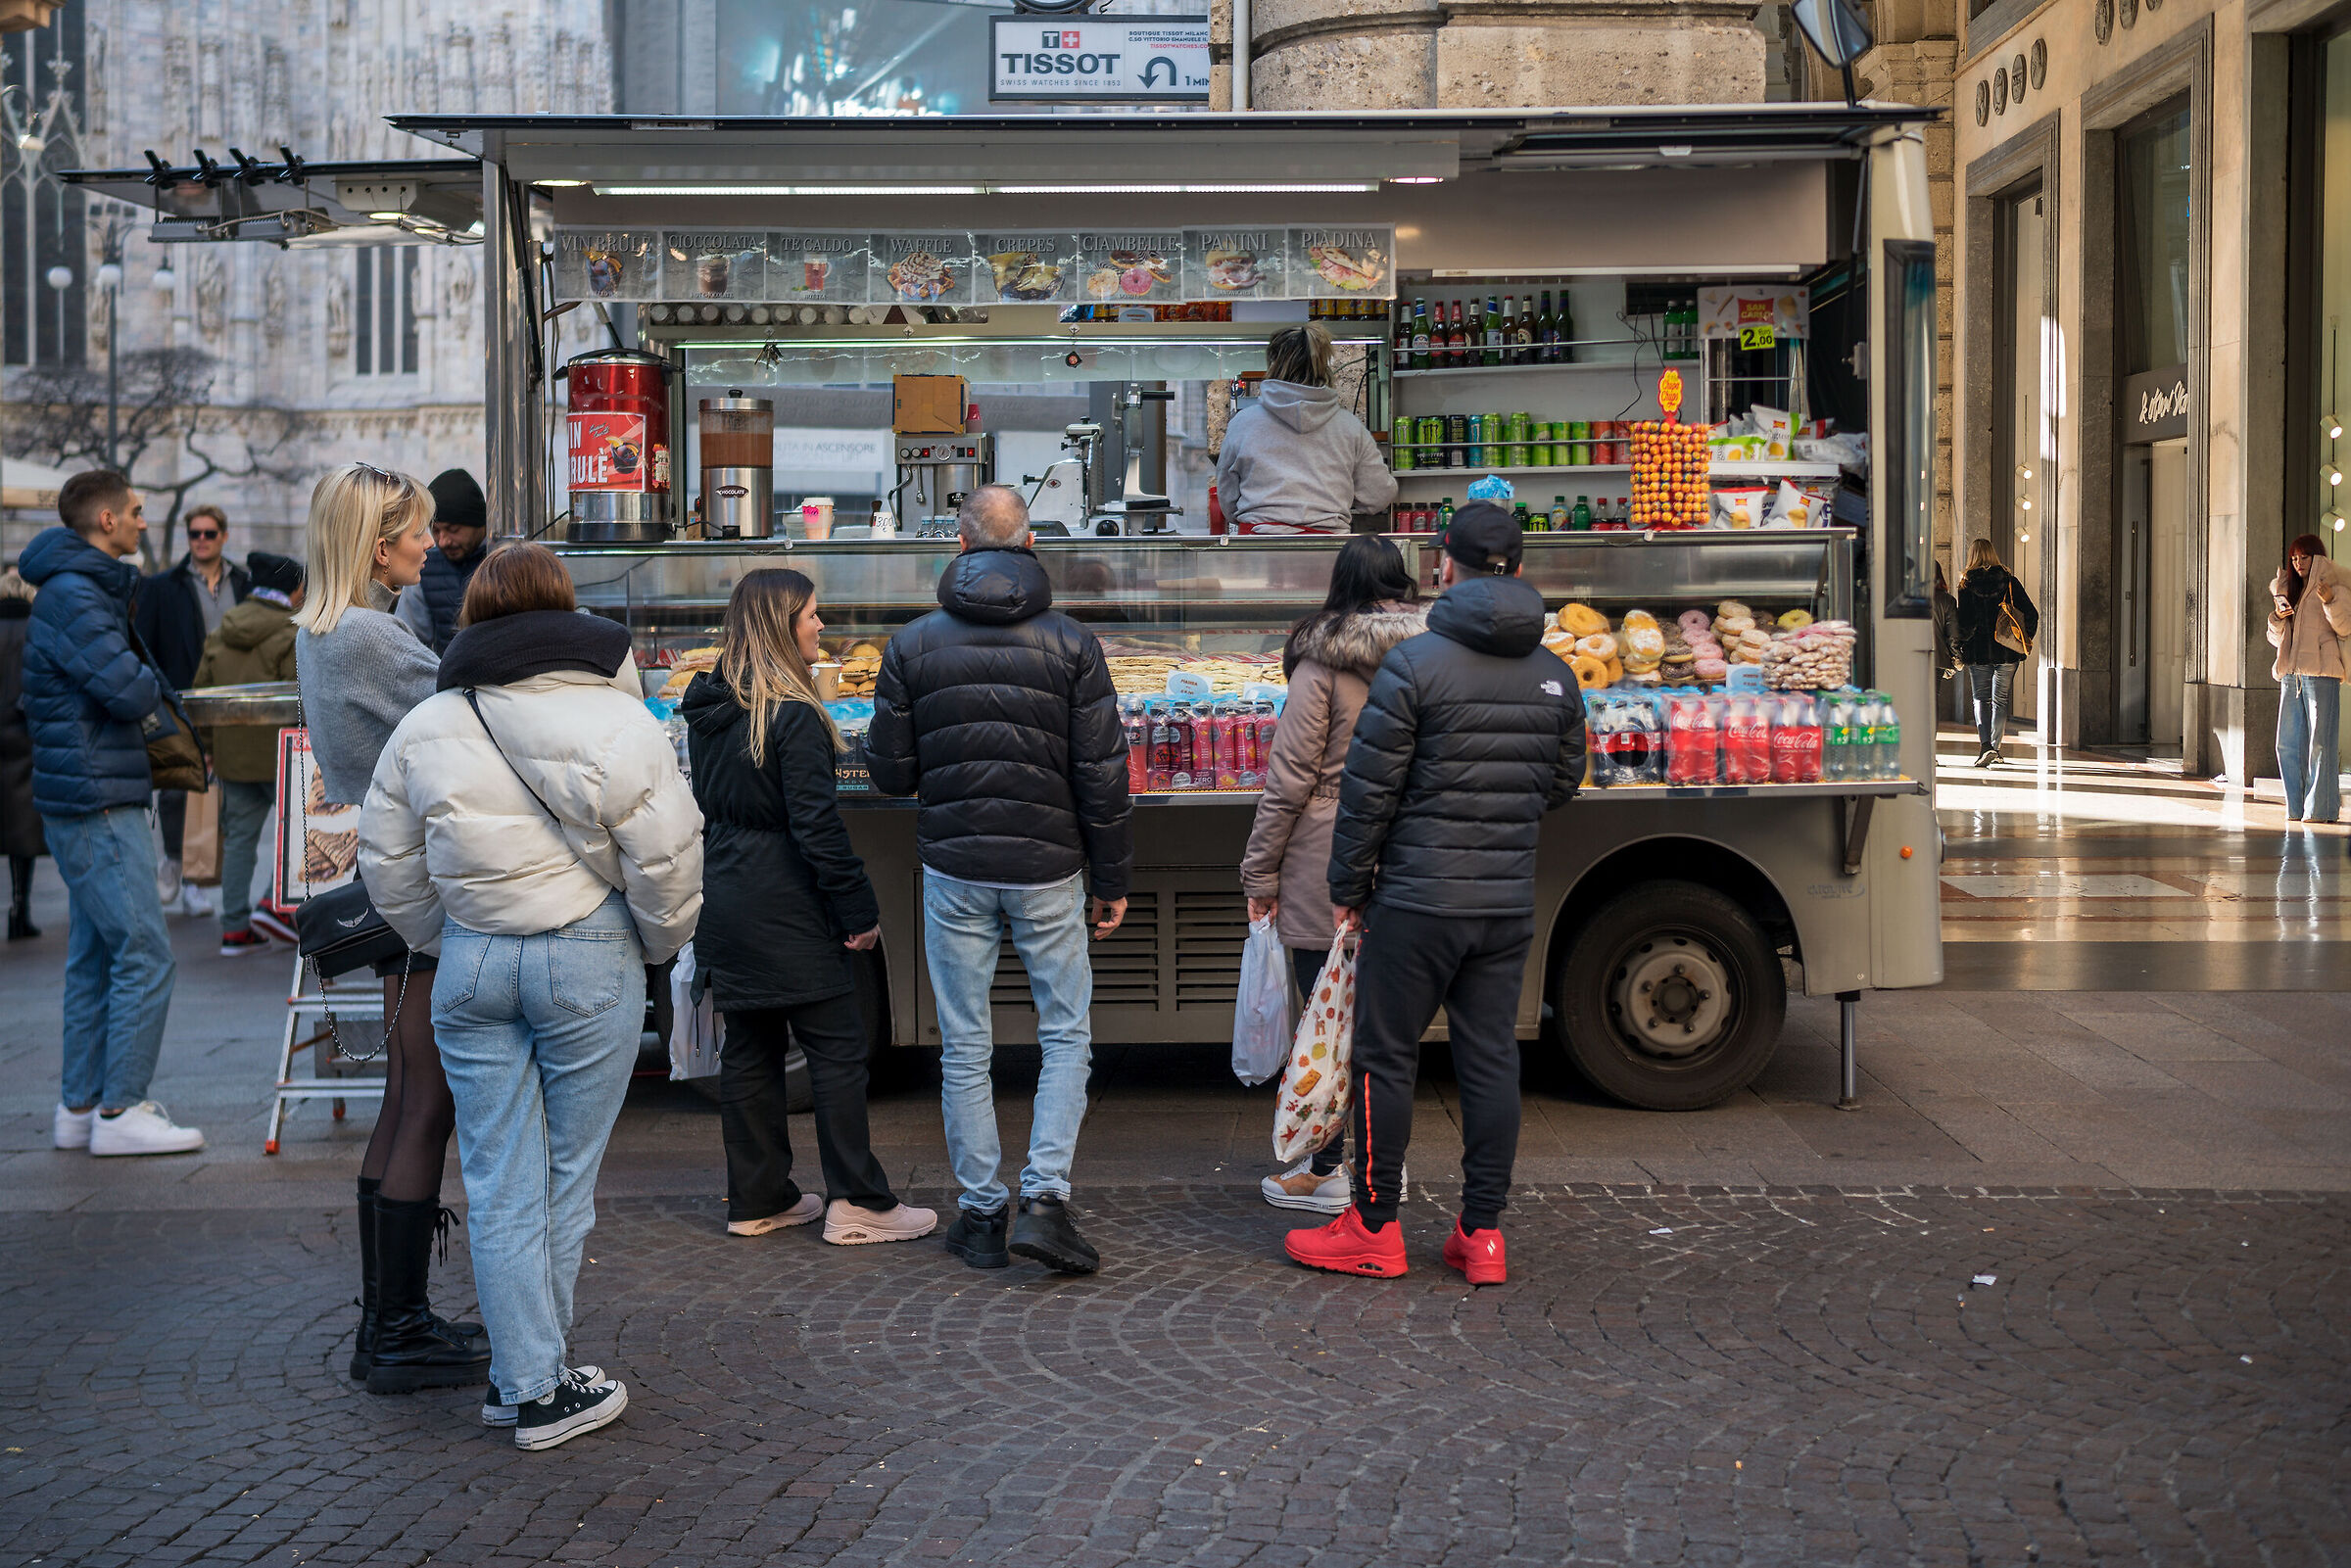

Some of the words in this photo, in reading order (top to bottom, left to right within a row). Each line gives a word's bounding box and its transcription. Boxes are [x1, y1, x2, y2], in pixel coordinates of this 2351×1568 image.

[1000, 53, 1122, 74] TISSOT
[1184, 75, 1190, 86] 1
[560, 235, 592, 253] VIN
[668, 234, 760, 250] CIOCCOLATA
[803, 237, 853, 253] CALDO
[889, 237, 953, 254] WAFFLE
[996, 237, 1056, 253] CREPES
[1081, 235, 1178, 253] CIAMBELLE
[1200, 233, 1269, 252] PANINI
[1301, 231, 1378, 250] PIADINA
[1742, 328, 1773, 348] 2,00
[568, 421, 582, 450] IN
[568, 447, 608, 484] RULÈ
[835, 768, 870, 780] NSTE
